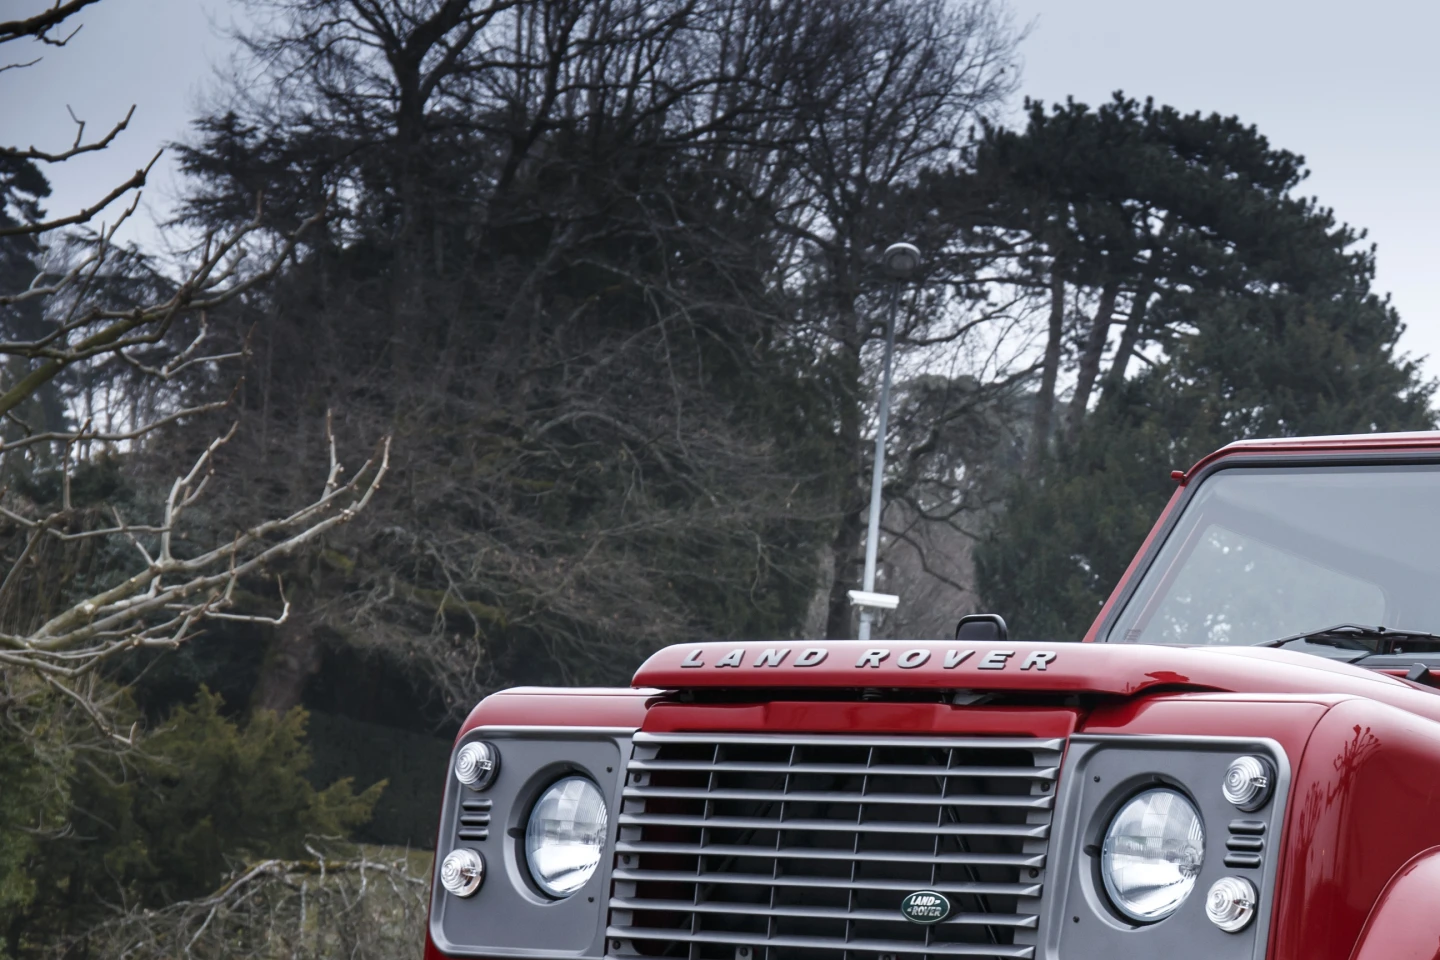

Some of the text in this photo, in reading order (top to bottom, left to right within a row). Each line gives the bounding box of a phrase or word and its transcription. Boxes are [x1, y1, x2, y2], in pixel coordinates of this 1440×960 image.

[680, 648, 1058, 671] LAND ROVER
[909, 895, 936, 906] LAND
[911, 906, 942, 917] ROVER
